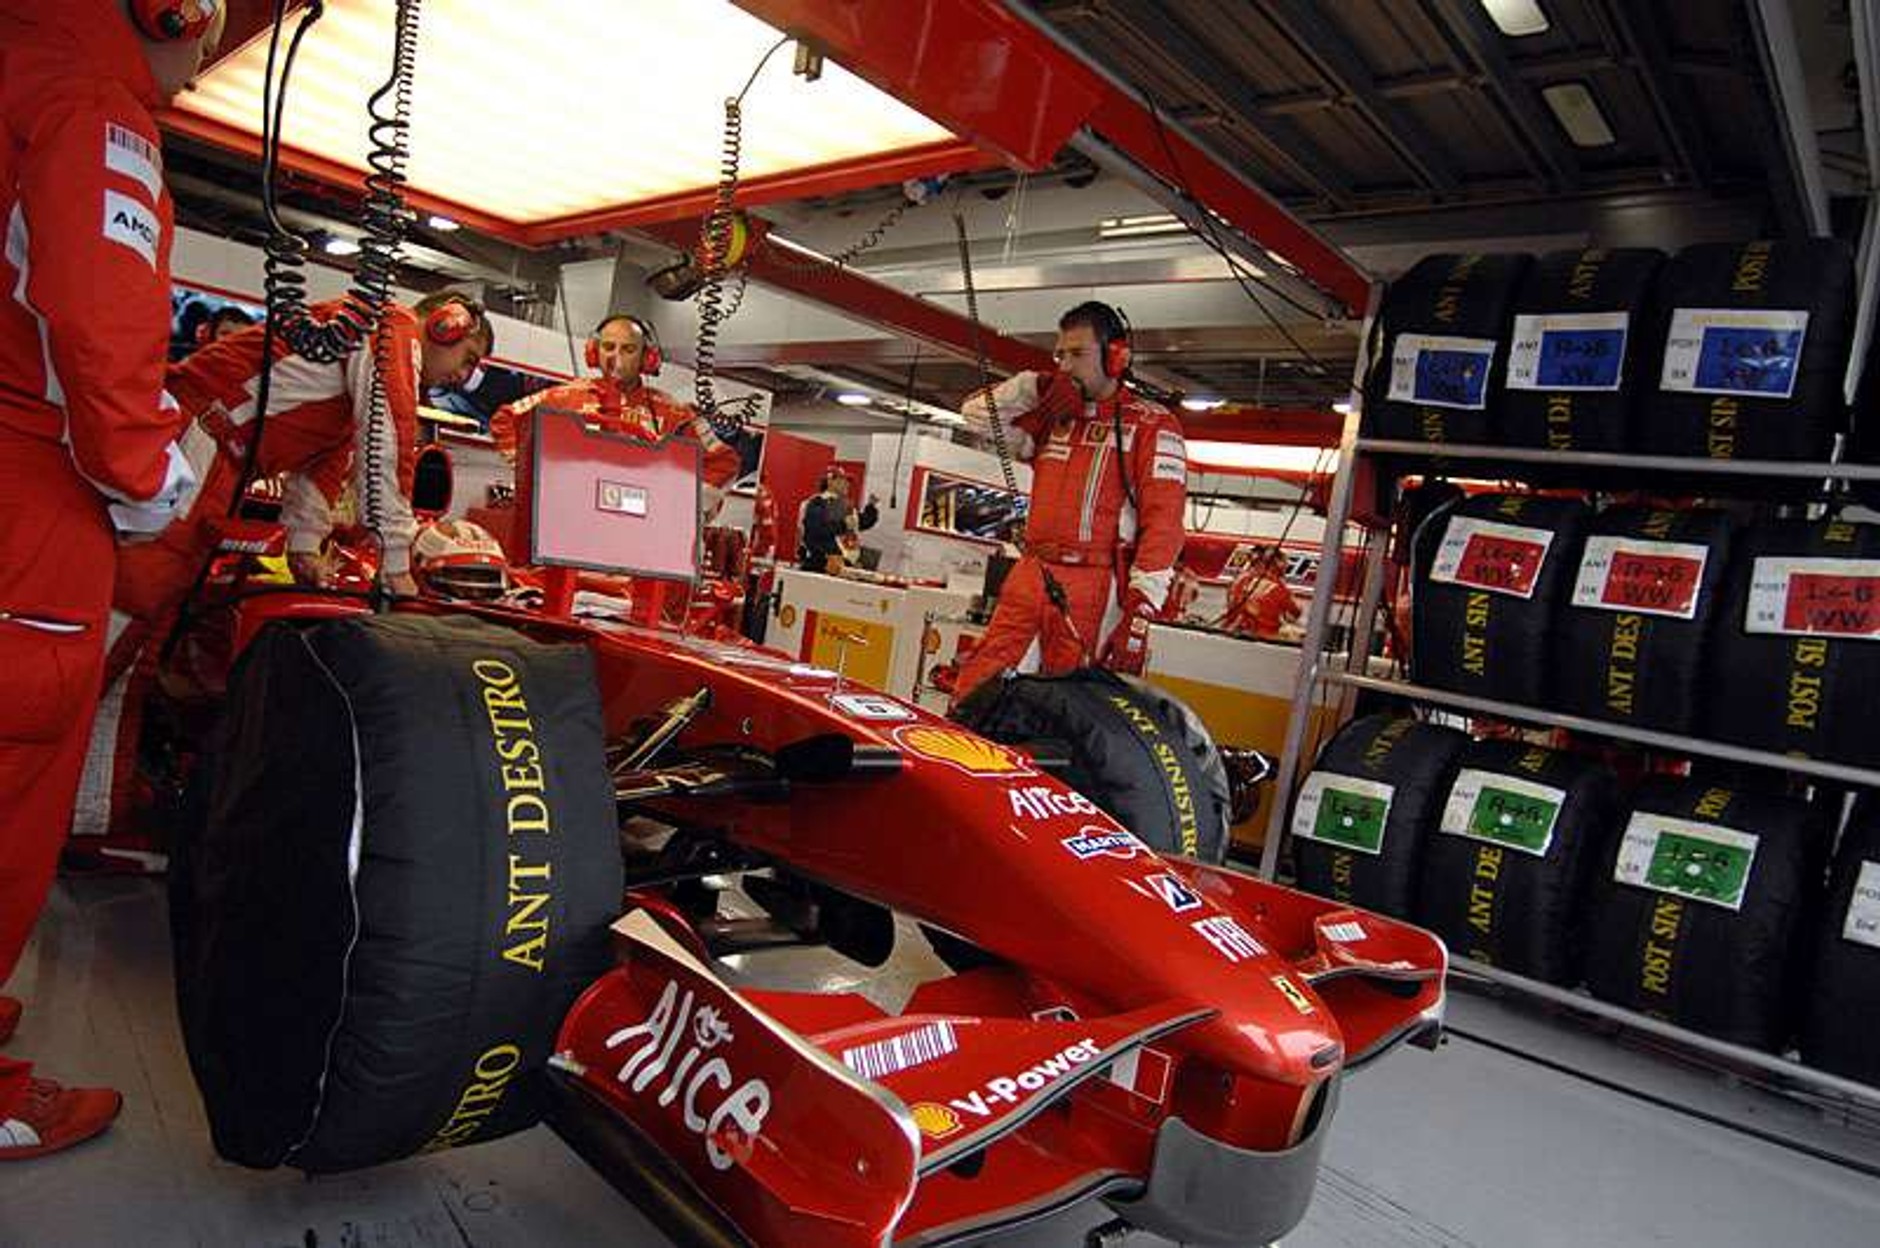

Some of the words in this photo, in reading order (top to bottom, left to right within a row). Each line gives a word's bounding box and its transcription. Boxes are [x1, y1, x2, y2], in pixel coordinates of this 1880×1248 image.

[1466, 592, 1489, 627] SIN
[1462, 631, 1485, 677] ANT
[1612, 614, 1644, 662] DES
[1607, 665, 1637, 715] ANT
[1786, 671, 1822, 730] POST
[1110, 697, 1160, 734] ANT
[472, 659, 550, 835] DESTRO
[1008, 785, 1098, 820] Alice
[502, 855, 553, 973] ANT
[1467, 885, 1497, 934] ANT
[1651, 899, 1685, 941] SIN
[1641, 939, 1674, 995] POST
[605, 980, 771, 1171] Alice
[950, 1037, 1101, 1117] V-Power
